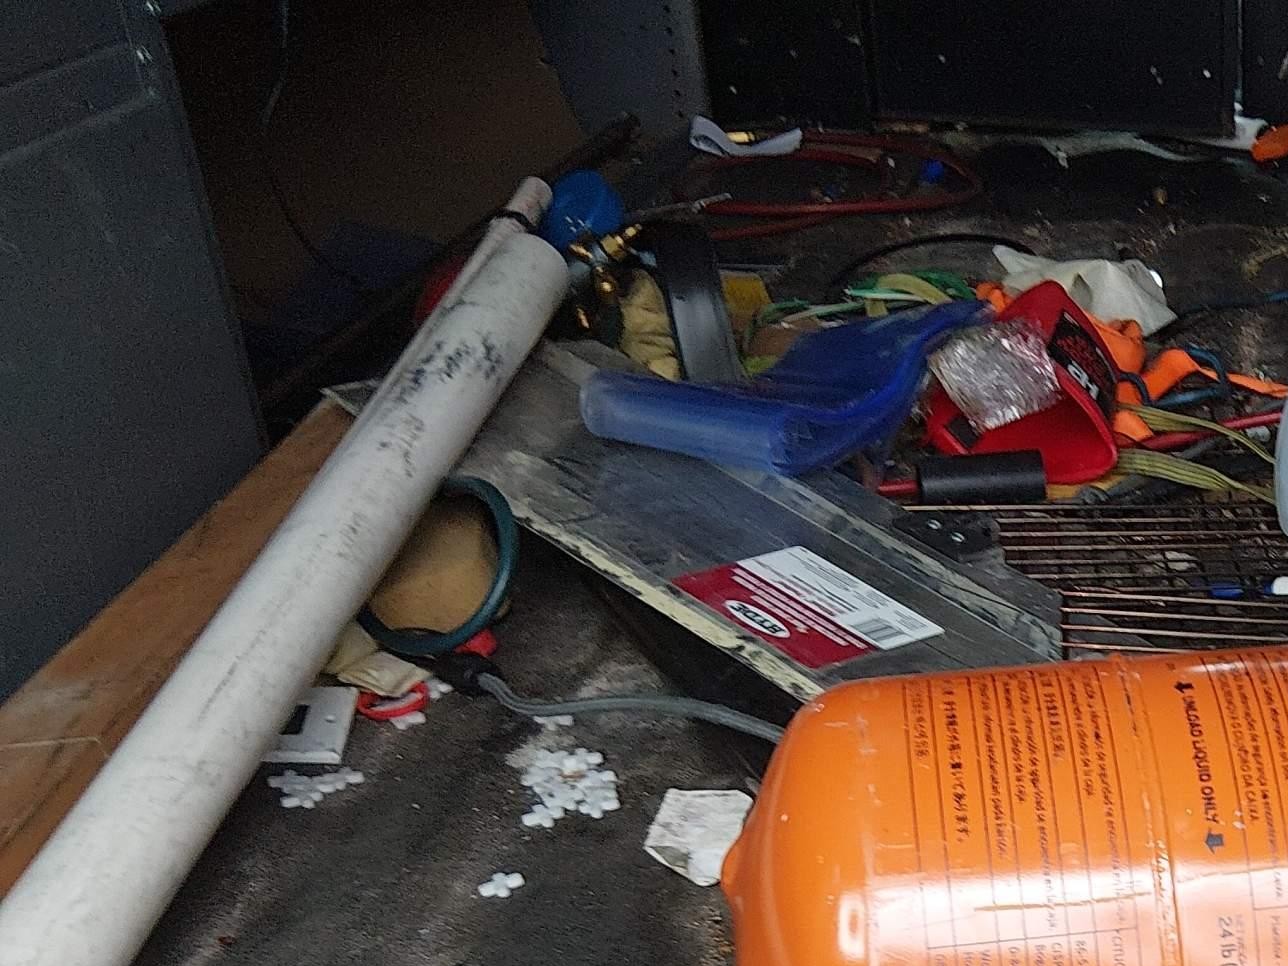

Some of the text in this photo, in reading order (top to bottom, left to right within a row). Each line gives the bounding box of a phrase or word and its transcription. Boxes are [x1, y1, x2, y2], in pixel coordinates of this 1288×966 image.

[729, 598, 785, 637] HYDE
[1192, 738, 1212, 783] LIQUID
[1218, 915, 1232, 940] 24
[1220, 942, 1236, 959] lb
